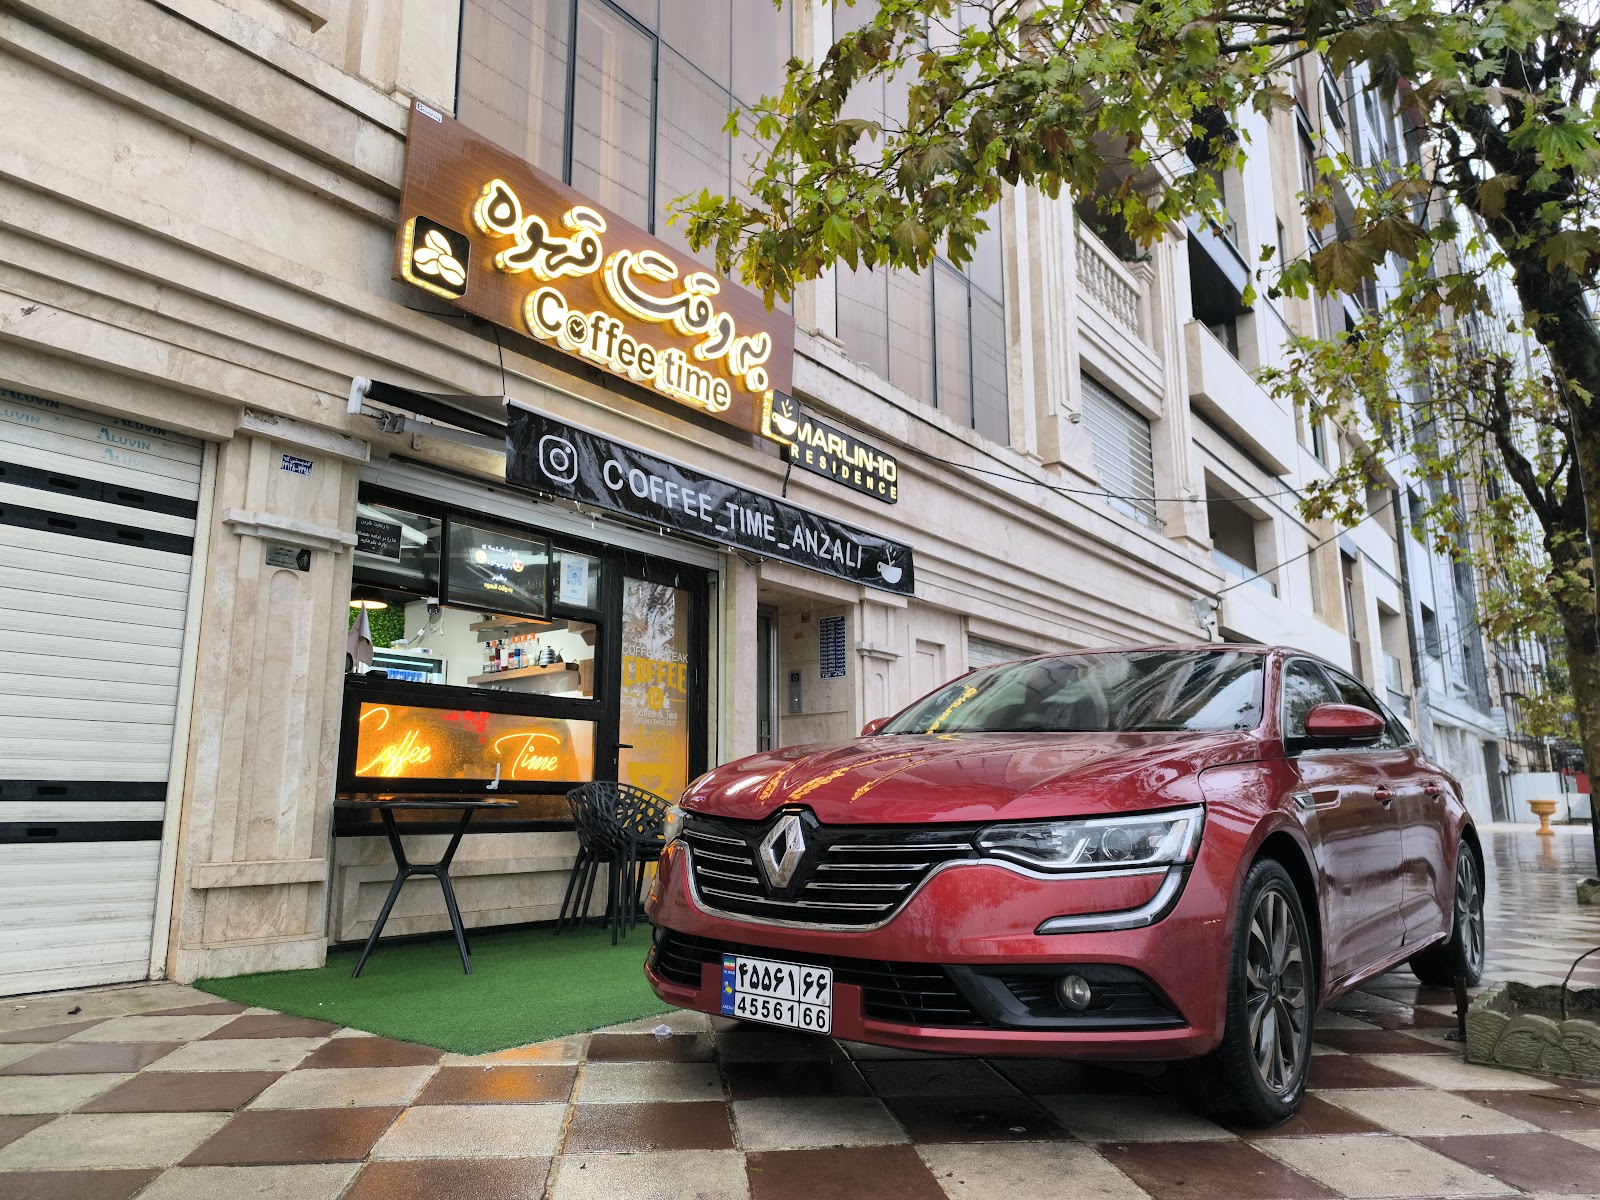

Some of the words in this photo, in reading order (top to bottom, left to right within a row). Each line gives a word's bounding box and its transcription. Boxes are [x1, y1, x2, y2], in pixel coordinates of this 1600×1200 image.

[475, 179, 606, 280] قهوه
[604, 249, 735, 361] وقت
[530, 286, 657, 381] Coffee
[662, 347, 731, 412] time
[96, 426, 151, 450] ALUVIN
[101, 447, 152, 471] ALUVI
[797, 422, 897, 482] MARLIN-10
[791, 443, 897, 499] RESIDENCE
[623, 655, 688, 695] COFFEE
[633, 707, 656, 718] Coffee
[658, 710, 664, 718] &
[666, 710, 678, 720] Tea
[356, 707, 431, 777] Coffee
[494, 733, 560, 779] Time
[738, 962, 795, 996] ۴۵۵۶۱
[802, 972, 828, 1000] ۶۶
[738, 996, 794, 1023] 45561
[803, 1007, 826, 1029] 66
